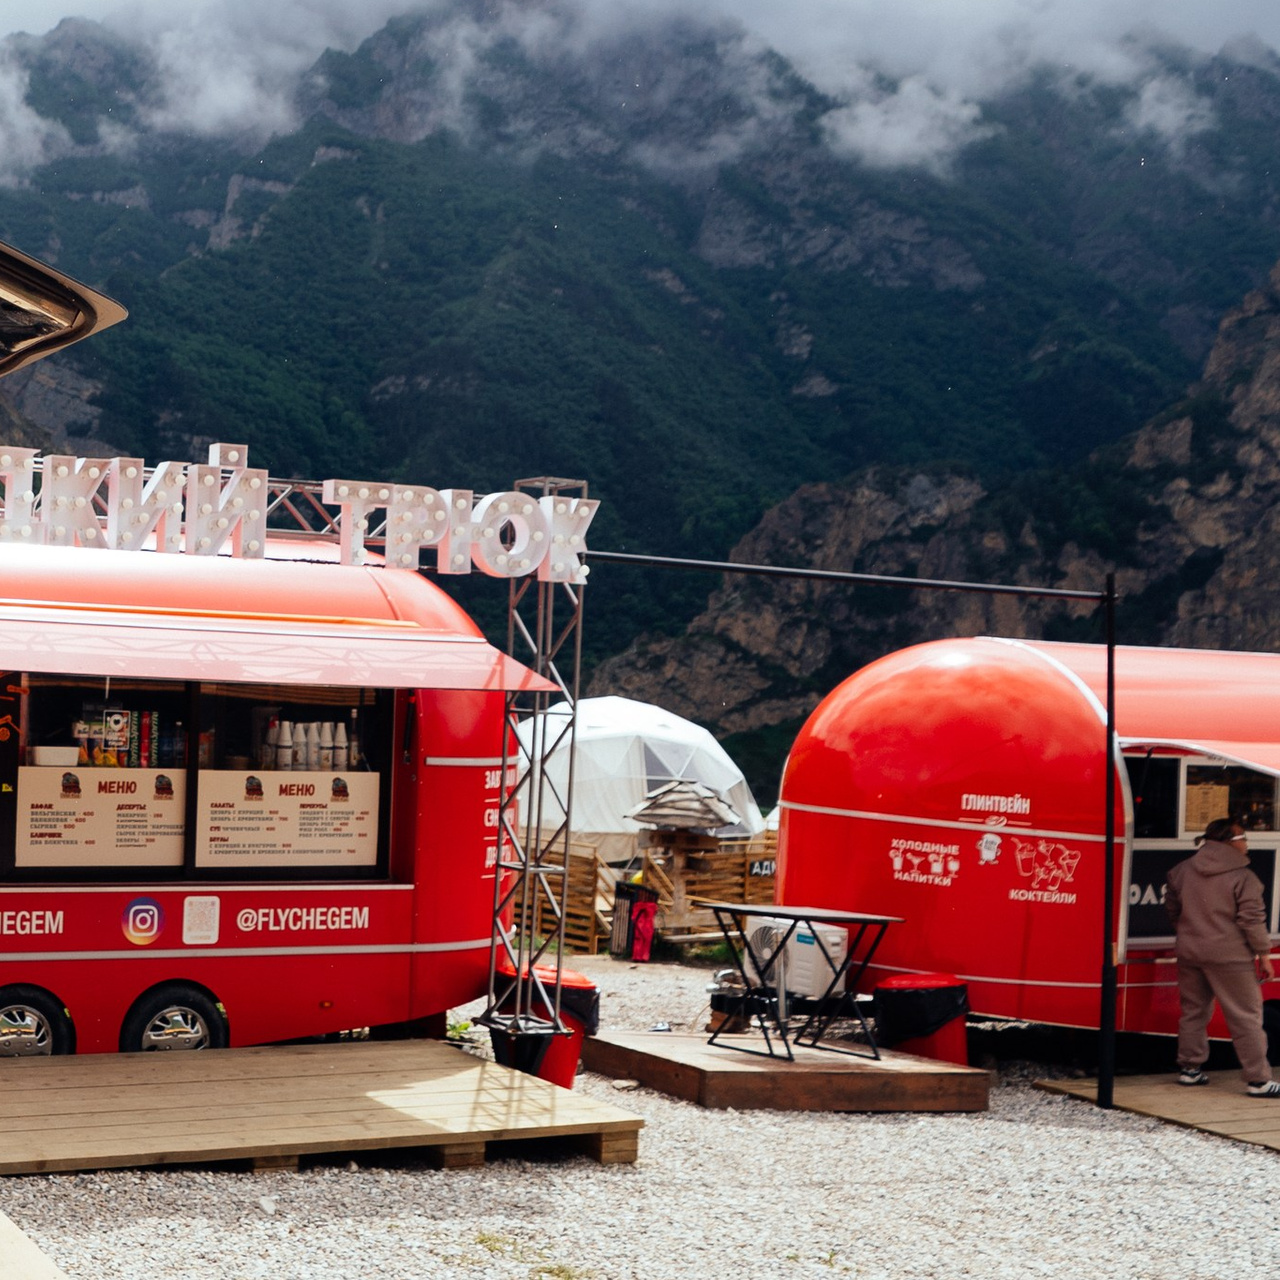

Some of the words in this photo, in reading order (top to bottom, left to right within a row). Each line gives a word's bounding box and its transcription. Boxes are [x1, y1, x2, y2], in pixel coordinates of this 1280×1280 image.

[322, 478, 601, 585] ТРЮК
[97, 780, 137, 794] МЕНЮ
[278, 783, 316, 796] МЕНЮ
[961, 793, 1030, 814] ГЛИНТВЕЙН
[891, 838, 960, 855] ХОЛОДНЫЕ
[894, 871, 951, 887] НАПИТКИ
[1008, 888, 1077, 904] КОКТЕЙЛИ
[235, 906, 370, 932] @FLYCHEGEM
